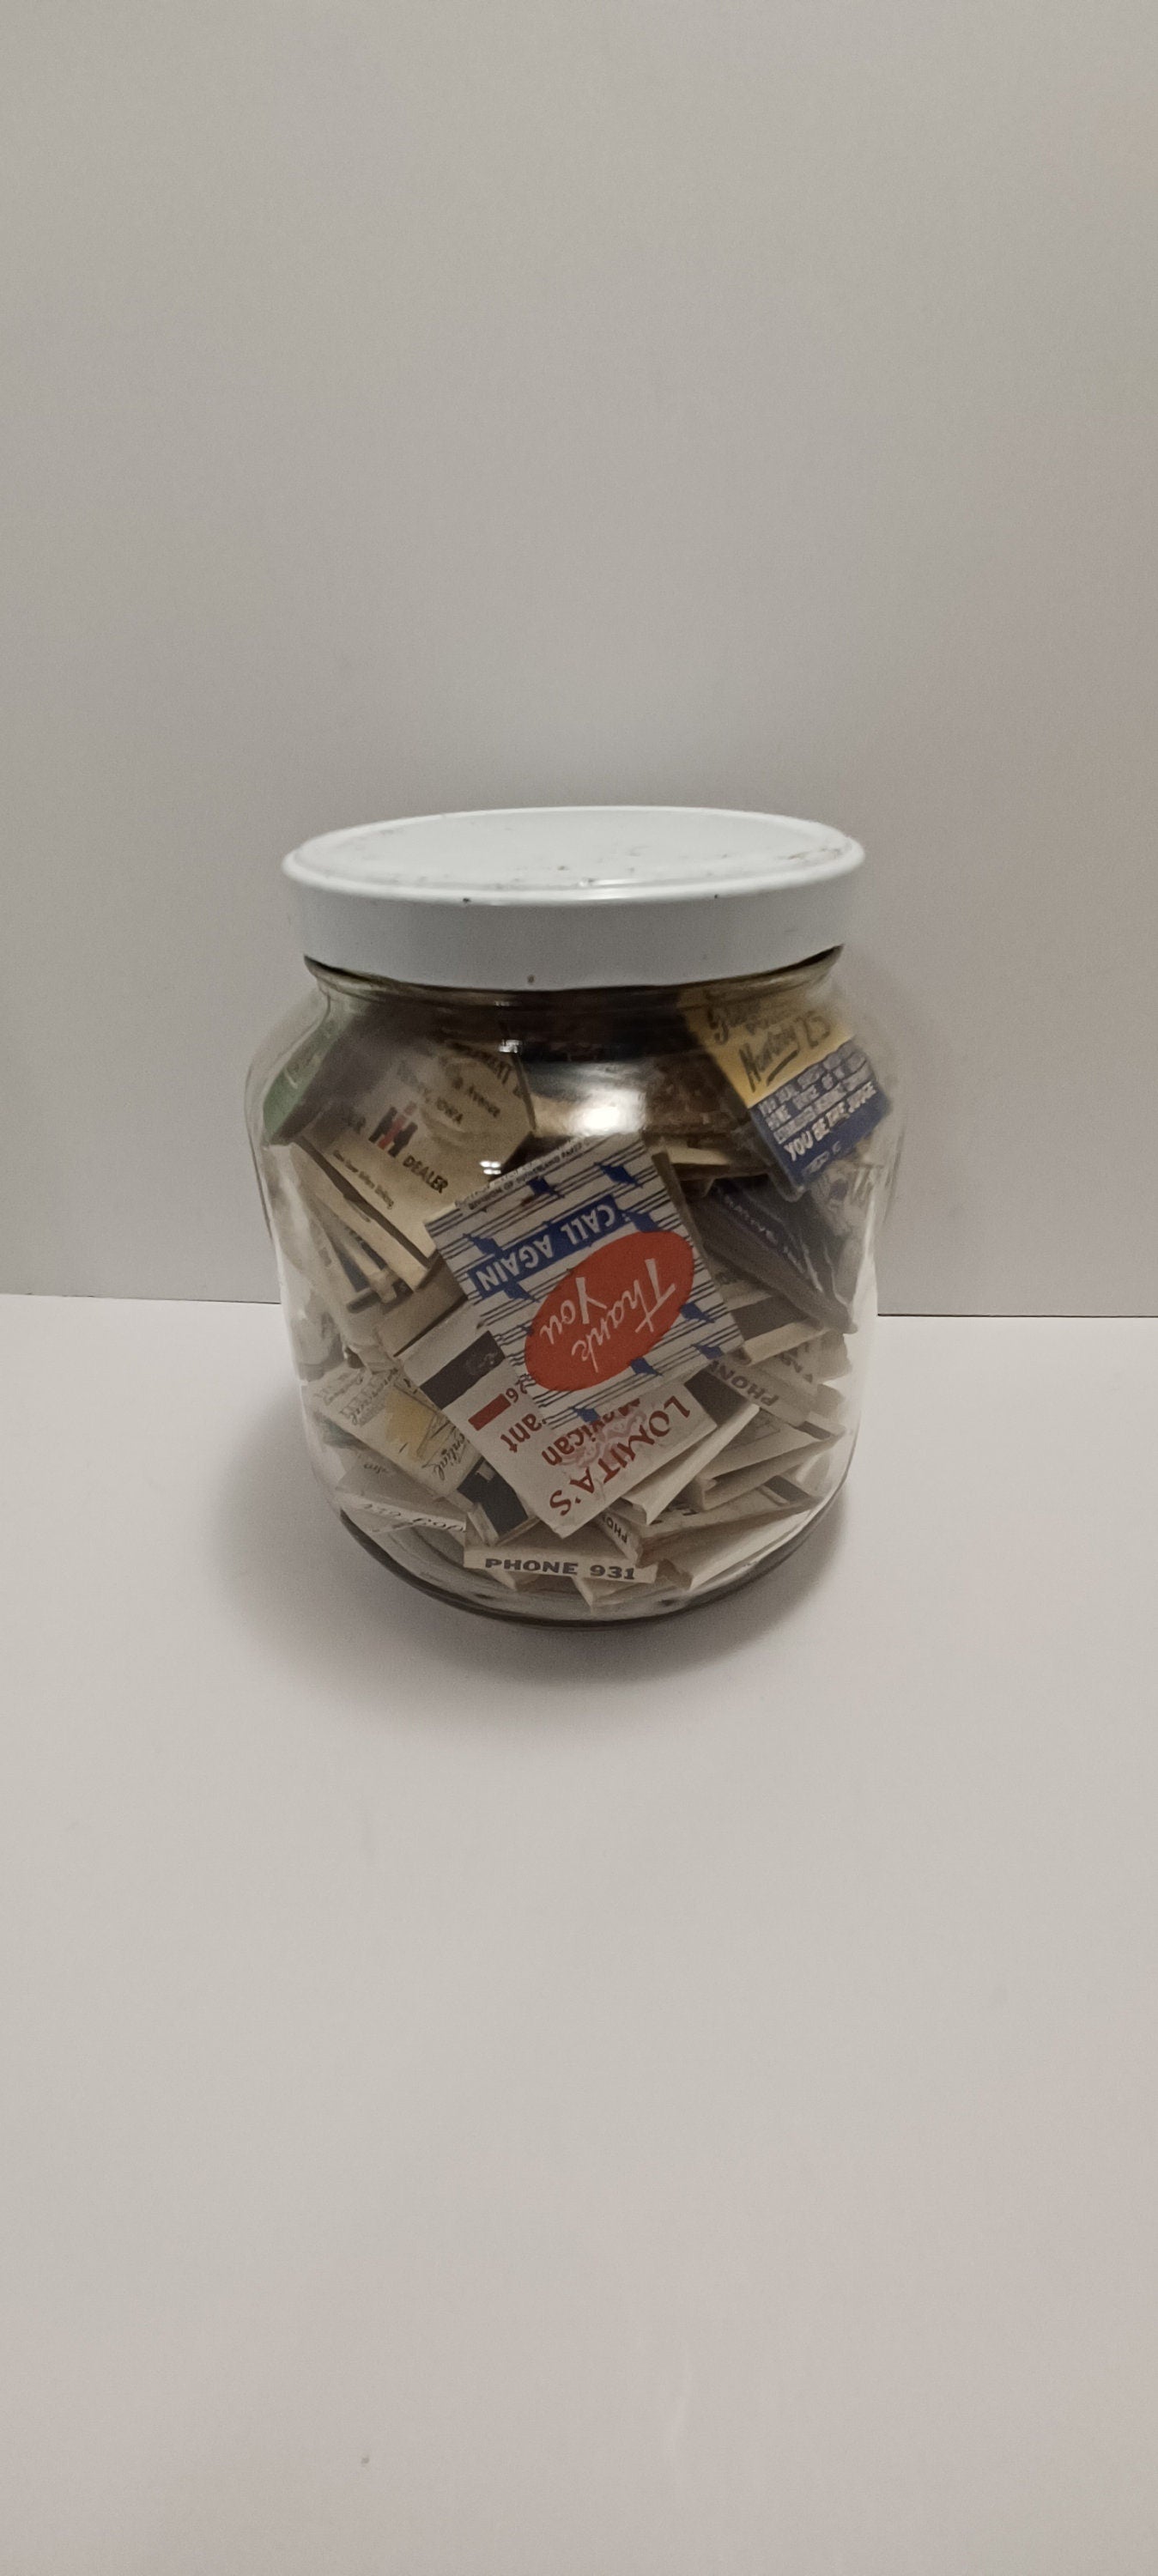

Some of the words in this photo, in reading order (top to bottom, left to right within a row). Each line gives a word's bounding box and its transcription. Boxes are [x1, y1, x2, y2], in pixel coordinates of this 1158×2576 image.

[783, 1130, 815, 1162] YOU
[402, 1155, 449, 1194] DEALER
[561, 1203, 616, 1247] CALL
[475, 1234, 554, 1291] AGAIN
[539, 1276, 608, 1346] You
[570, 1257, 676, 1374] Thank
[549, 1394, 691, 1517] LOMITA'S
[484, 1557, 579, 1576] PHONE
[589, 1564, 636, 1582] 931
